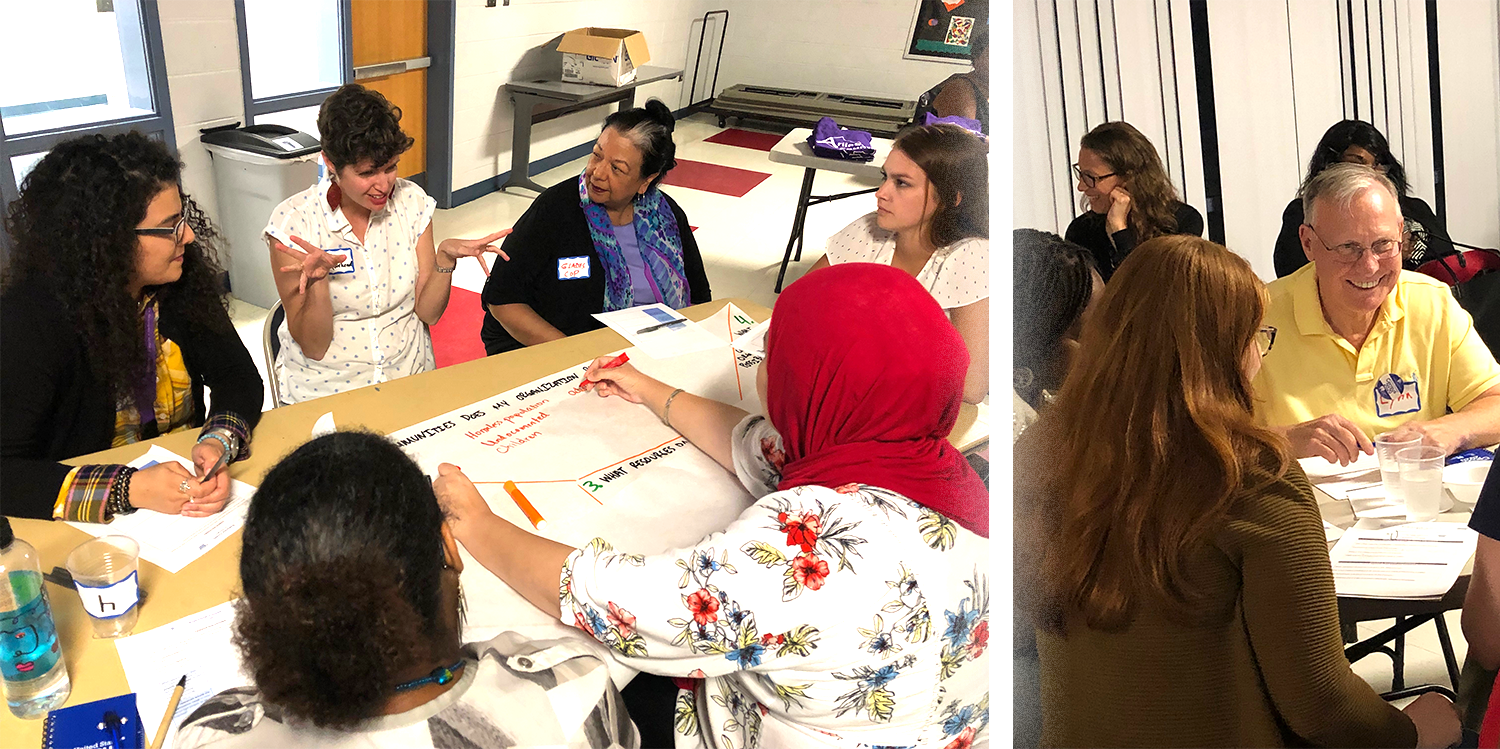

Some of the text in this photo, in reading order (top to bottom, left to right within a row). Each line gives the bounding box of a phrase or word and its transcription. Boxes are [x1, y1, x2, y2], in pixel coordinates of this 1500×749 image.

[734, 315, 754, 325] 4.
[460, 410, 486, 422] DOES
[492, 400, 510, 411] MY
[515, 373, 579, 401] ORGANIZATION
[496, 431, 543, 454] Children
[599, 466, 628, 483] WHAT
